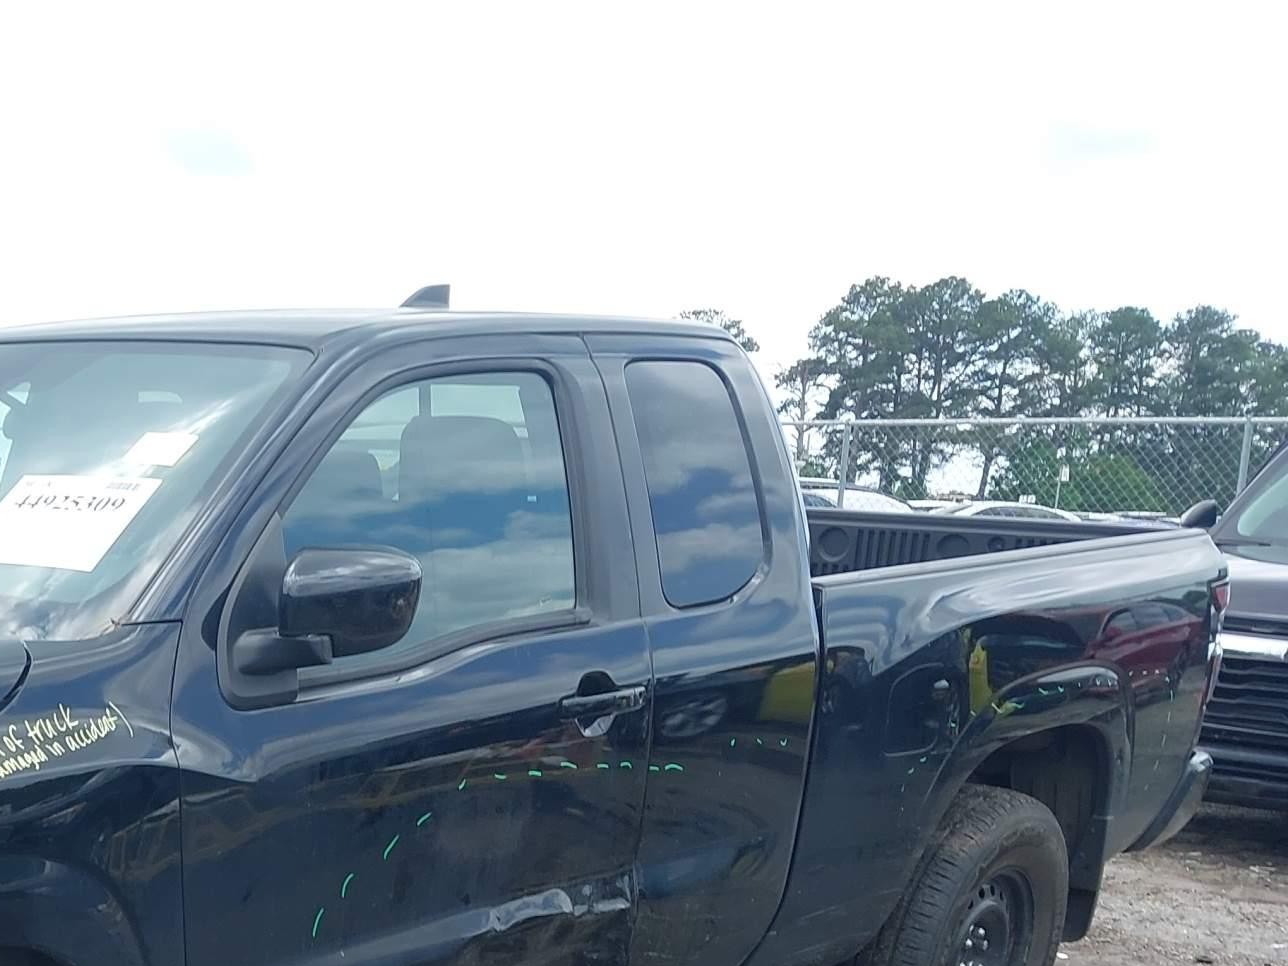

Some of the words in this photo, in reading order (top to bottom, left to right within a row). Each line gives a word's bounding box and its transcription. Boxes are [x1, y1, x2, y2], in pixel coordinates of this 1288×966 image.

[3, 724, 25, 753] of
[24, 703, 80, 746] truck
[45, 740, 66, 757] in
